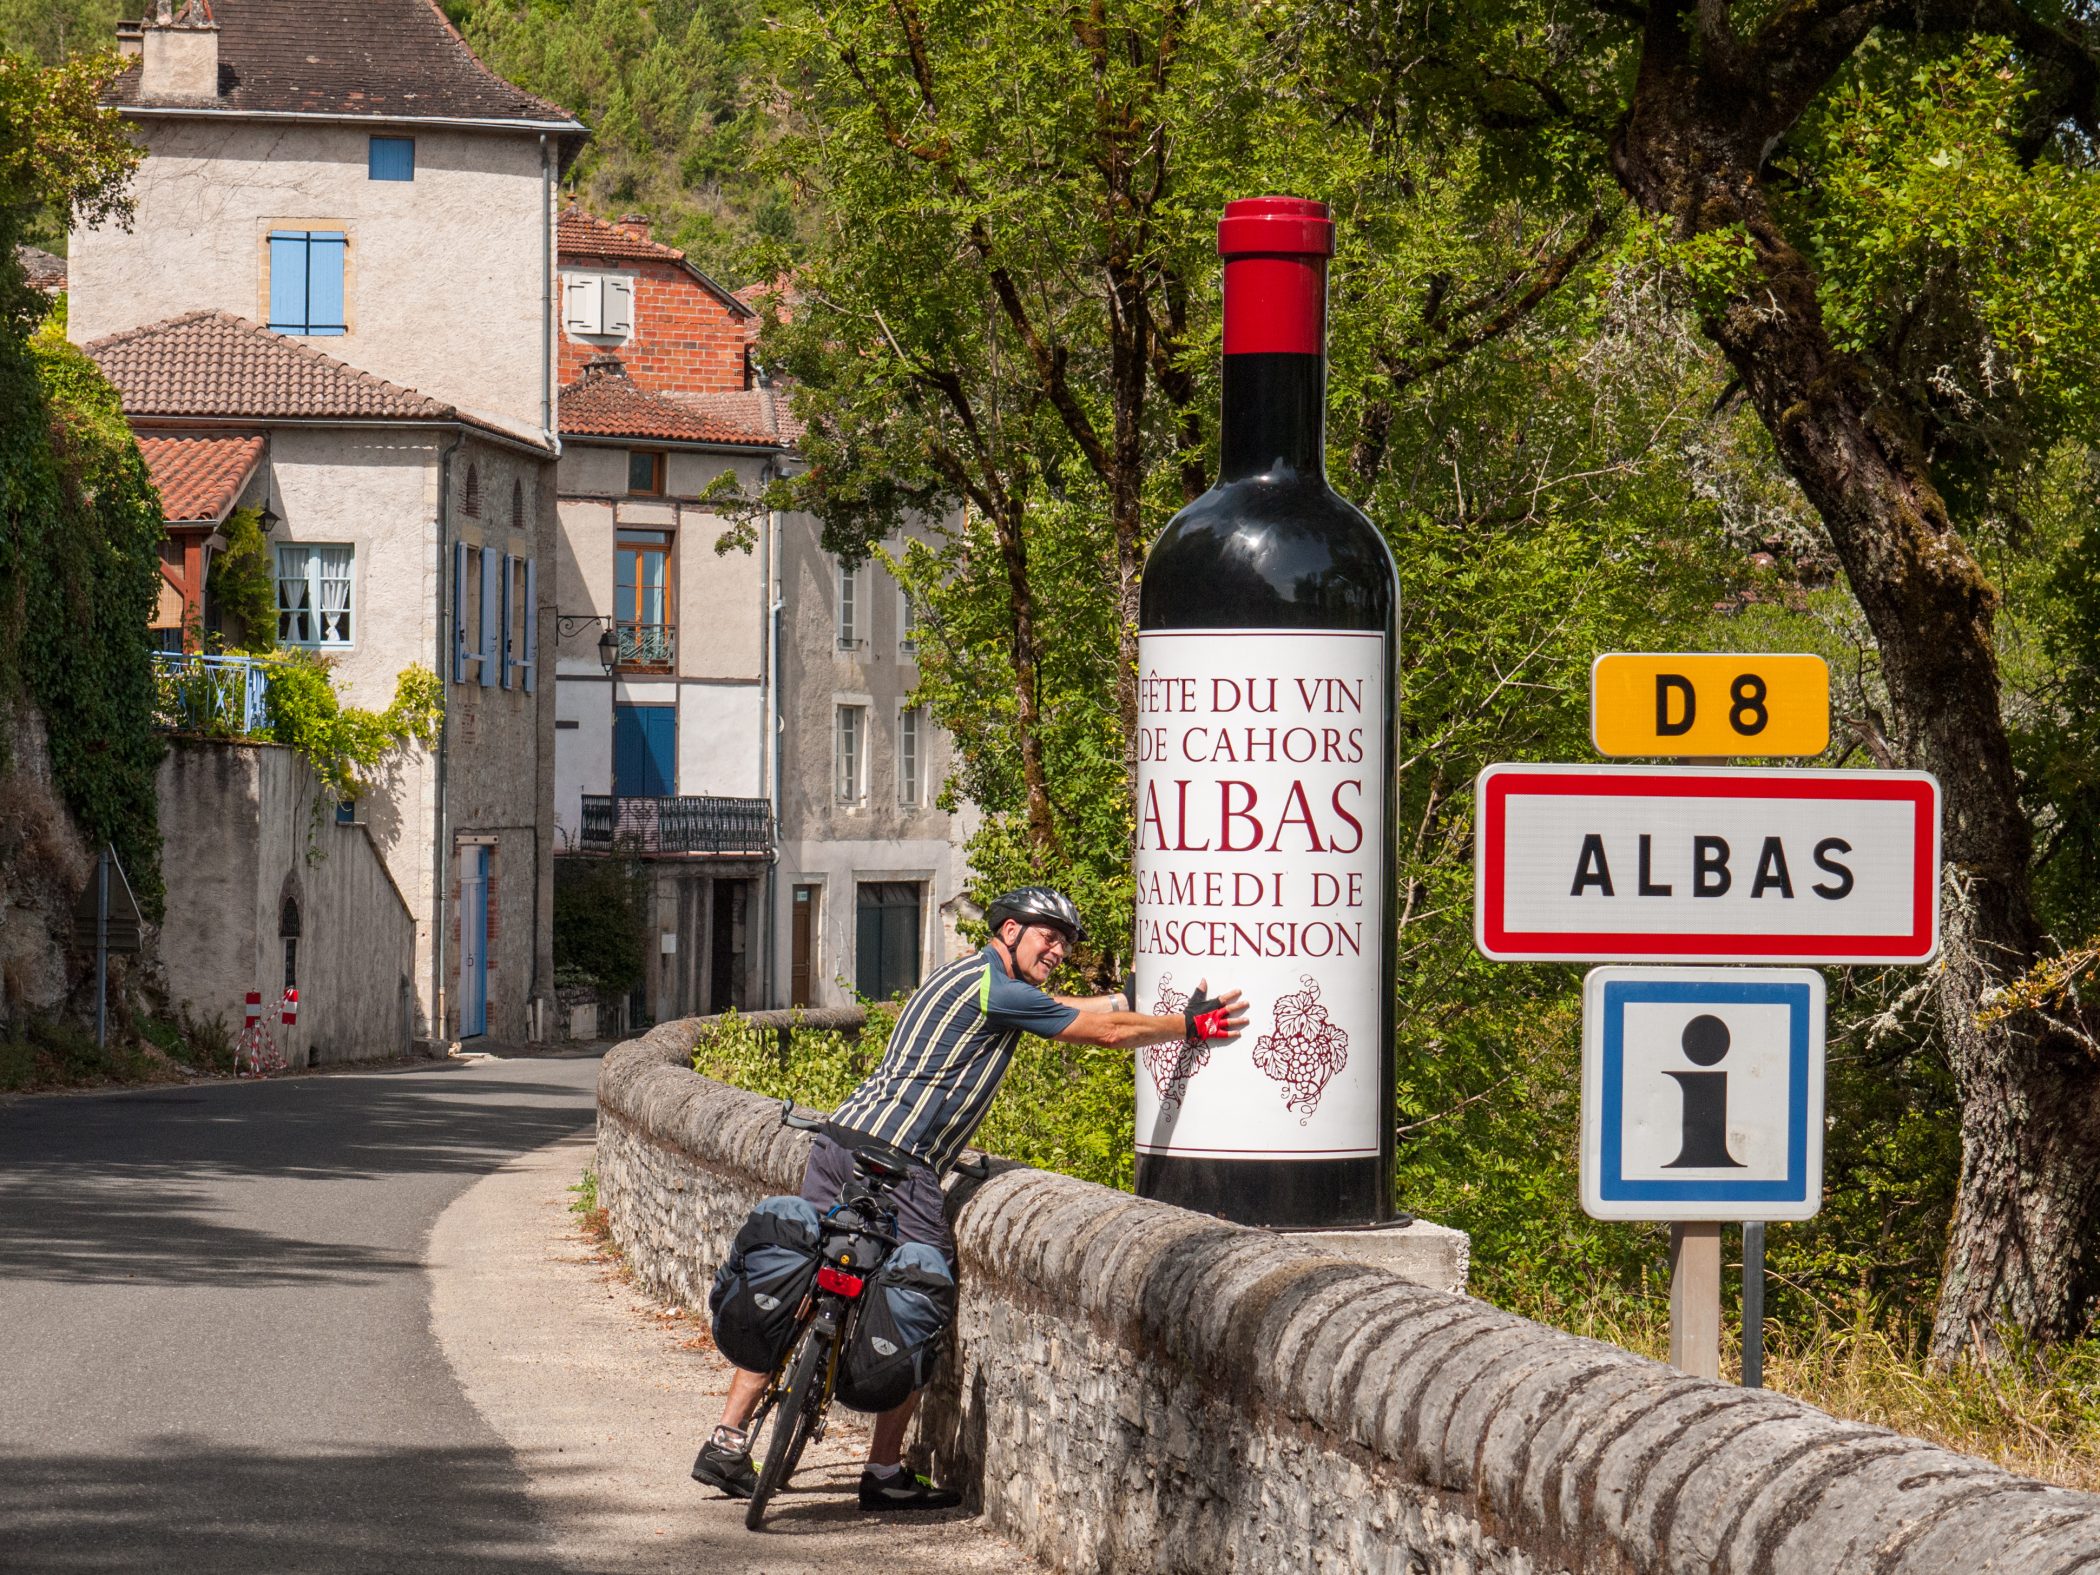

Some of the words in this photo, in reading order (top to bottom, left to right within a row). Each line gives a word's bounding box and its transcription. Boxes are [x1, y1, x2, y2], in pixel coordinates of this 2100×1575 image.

[1141, 669, 1197, 713] FÊTE
[1210, 677, 1278, 713] DU
[1294, 678, 1363, 714] VIN
[1656, 674, 1697, 737] D
[1729, 674, 1769, 736] 8
[1140, 727, 1168, 762] DE
[1182, 726, 1364, 763] CAHORS
[1139, 778, 1364, 854] ALBAS
[1138, 870, 1284, 908] SAMEDI
[1311, 872, 1363, 908] DE
[1570, 833, 1854, 900] ALBAS
[1138, 919, 1363, 958] L'ASCENSION
